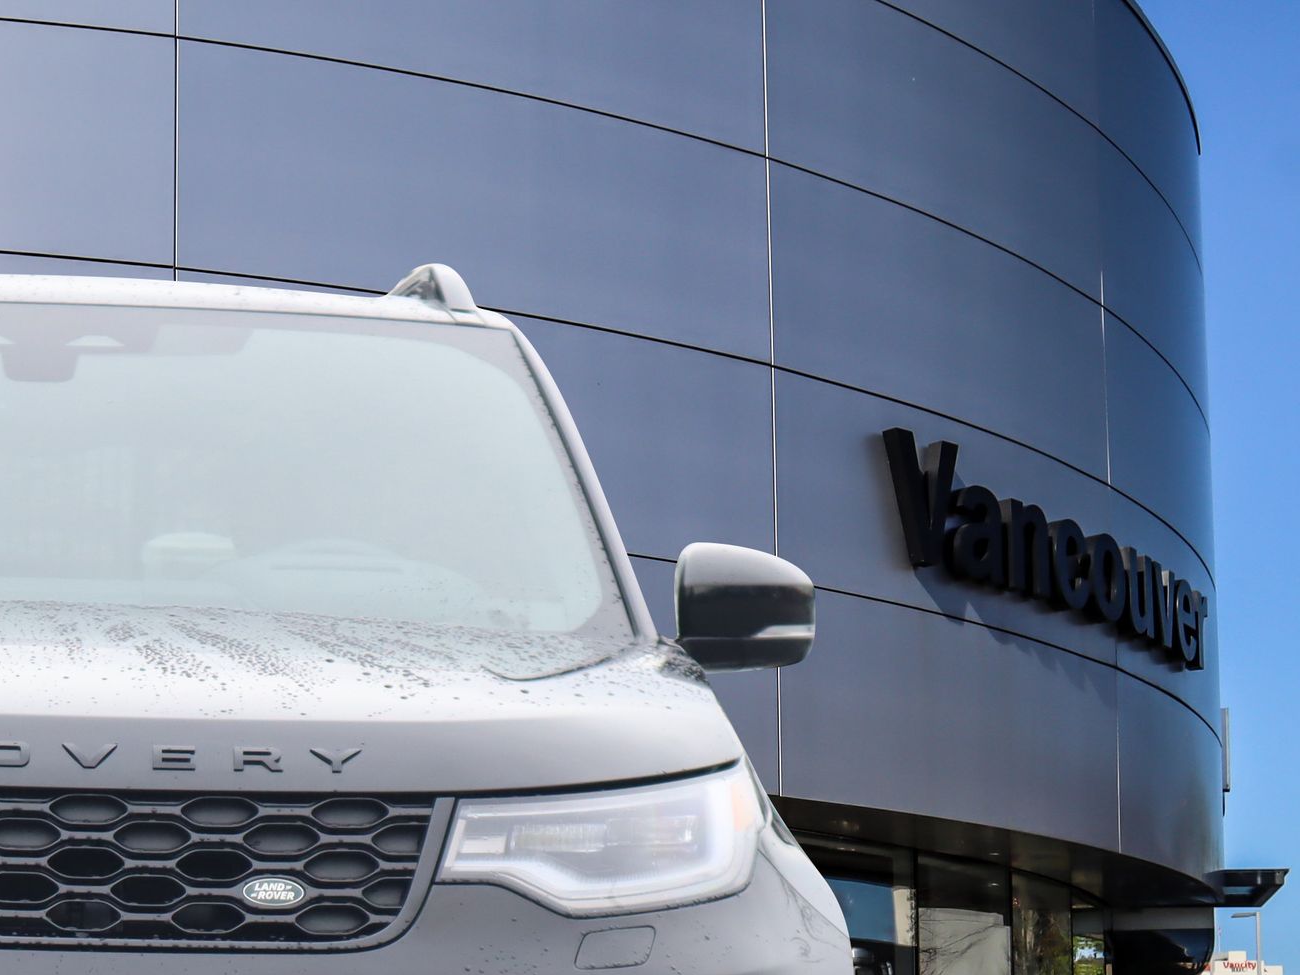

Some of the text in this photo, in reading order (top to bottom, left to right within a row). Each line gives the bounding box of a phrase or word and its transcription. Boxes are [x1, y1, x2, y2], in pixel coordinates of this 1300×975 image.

[882, 427, 1208, 670] Vancouver
[254, 882, 285, 891] LAND
[257, 891, 295, 900] ROVER
[1223, 960, 1257, 970] Vancity
